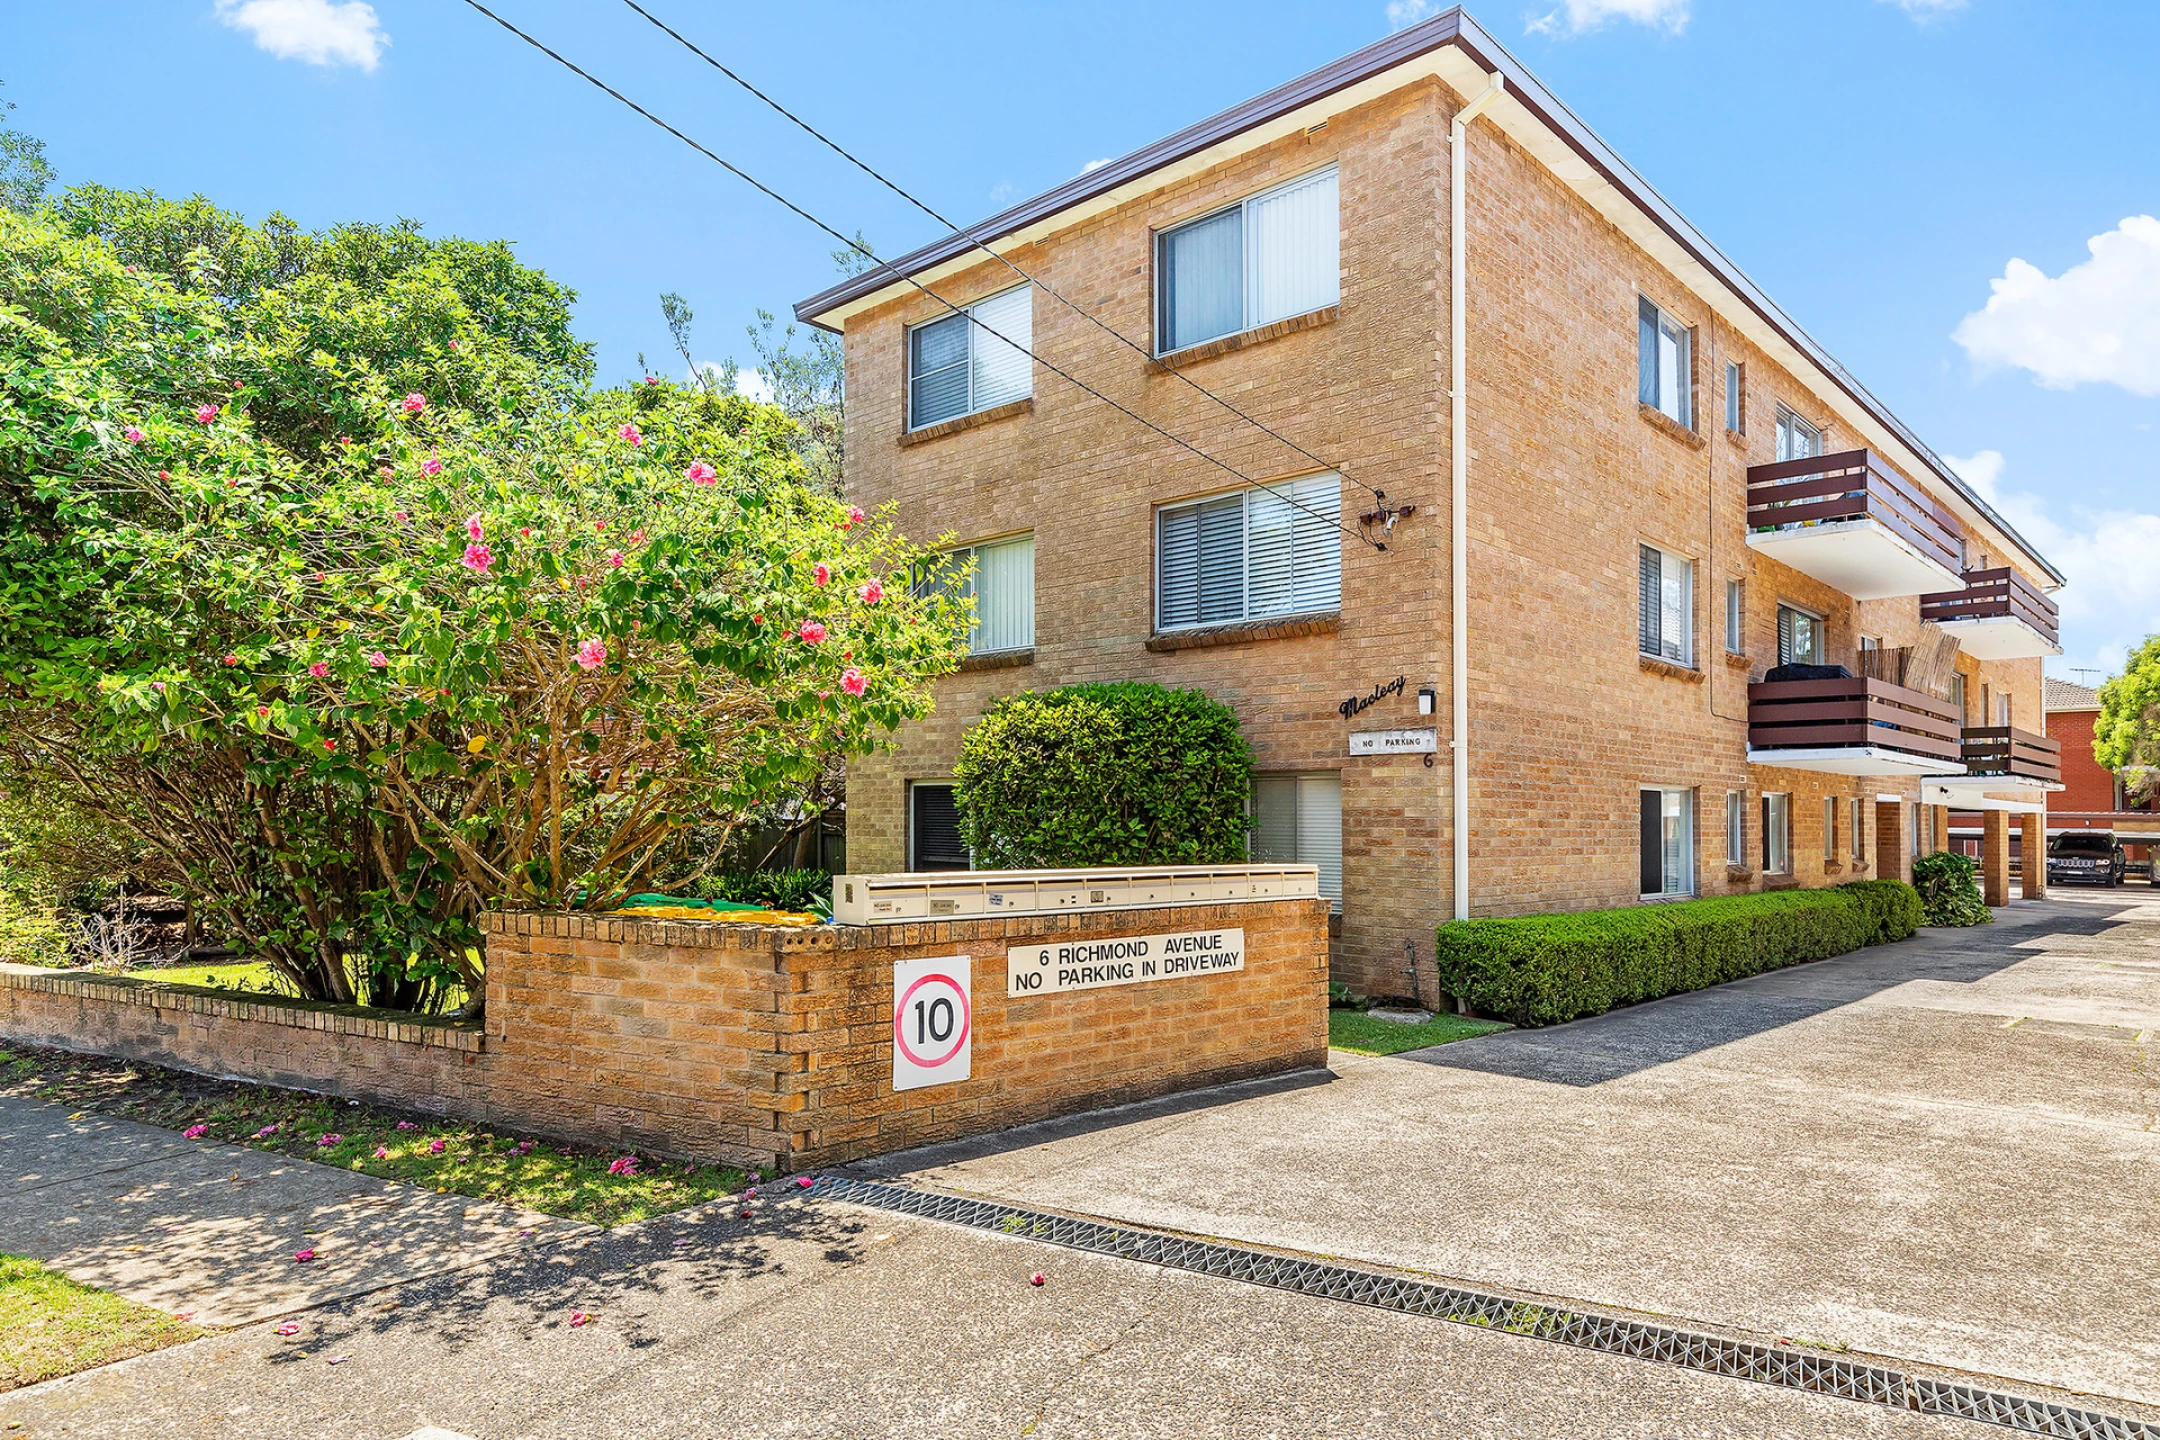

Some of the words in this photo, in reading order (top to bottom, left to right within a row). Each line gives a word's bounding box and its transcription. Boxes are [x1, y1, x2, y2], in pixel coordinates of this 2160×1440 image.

[1339, 675, 1406, 720] Macleay
[1362, 740, 1374, 748] NO
[1385, 737, 1421, 747] PARKING
[1423, 753, 1434, 768] 6
[1039, 950, 1050, 966] 6
[1059, 941, 1149, 965] RICHMOND
[1164, 935, 1222, 955] AVENUE
[1016, 972, 1043, 991] NO
[1059, 963, 1134, 986] PARKING
[1142, 961, 1156, 976] IN
[1164, 951, 1240, 974] DRIVEWAY
[915, 998, 954, 1044] 10
